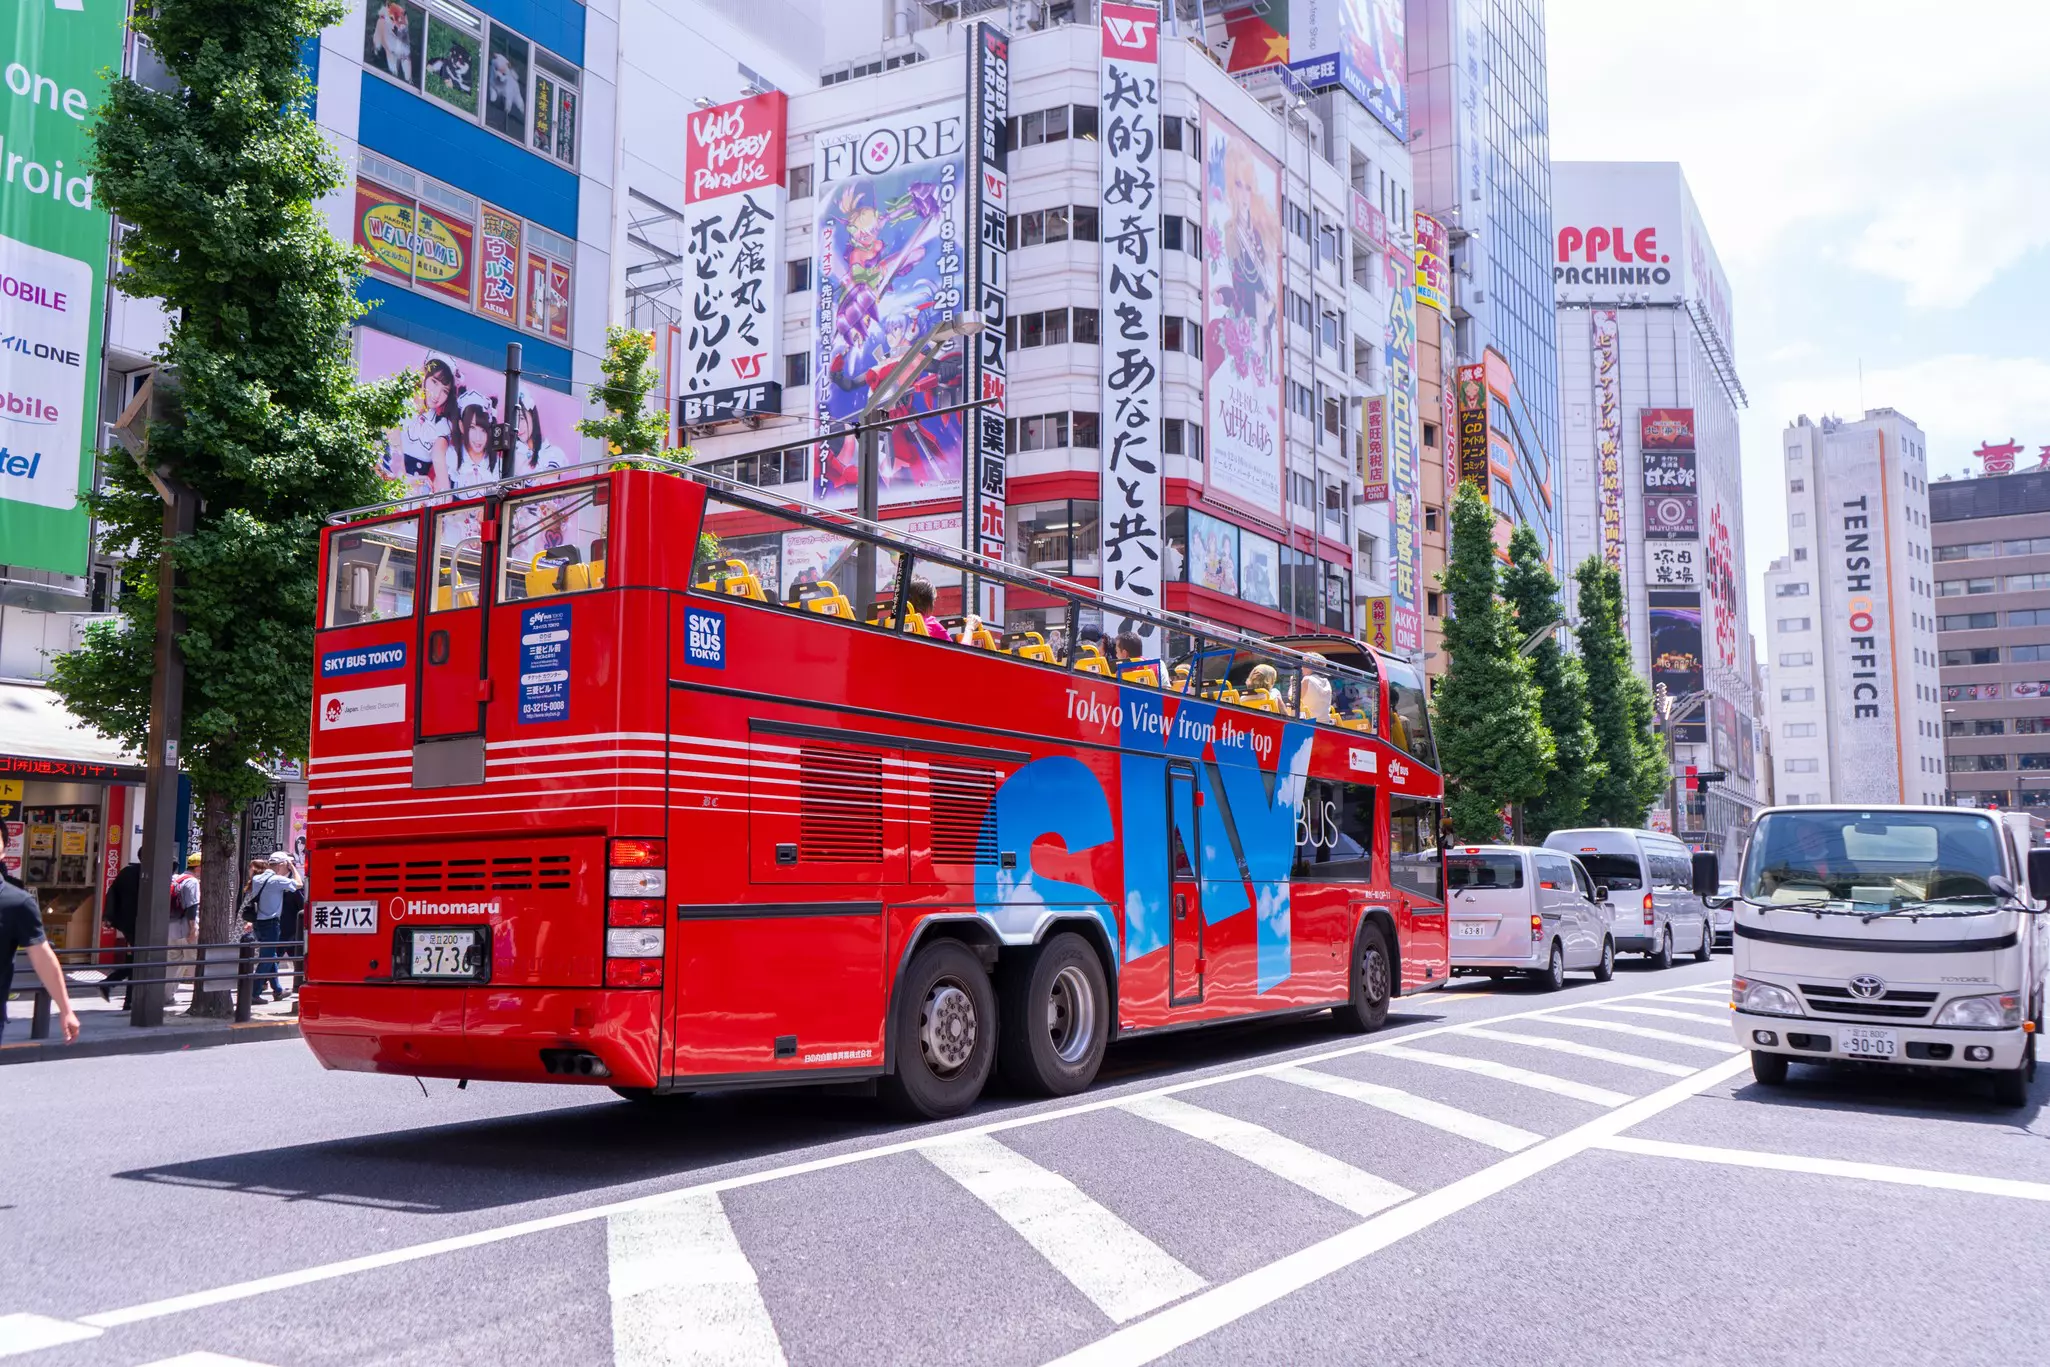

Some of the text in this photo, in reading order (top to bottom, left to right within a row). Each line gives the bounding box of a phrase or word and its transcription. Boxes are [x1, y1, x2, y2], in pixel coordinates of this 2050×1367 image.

[5, 62, 88, 121] one
[996, 40, 1008, 128] HOBBY
[983, 32, 997, 162] PARADISE
[819, 115, 965, 185] FIORE
[0, 135, 94, 211] roid
[693, 157, 770, 200] Paradise
[368, 215, 460, 269] WELCOME
[1552, 226, 1671, 264] PPLE.
[417, 260, 444, 276] AKIBA
[729, 192, 775, 347] 全館丸々
[1553, 266, 1671, 285] PACHINKO
[0, 273, 67, 312] OBILE
[483, 301, 510, 317] AKIBA
[1390, 259, 1409, 356] TAX
[0, 332, 32, 355] イル
[1392, 356, 1412, 485] FREE
[1462, 410, 1485, 422] ゲーム
[1465, 422, 1482, 434] CD
[1367, 399, 1384, 482] 愛客旺免税店
[1462, 435, 1485, 446] アイドル
[1462, 448, 1486, 459] アニメ
[1644, 455, 1656, 464] 7F
[1462, 461, 1486, 472] コミック
[1644, 467, 1696, 488] 甘太郎
[1365, 484, 1387, 494] AKKY
[1367, 492, 1385, 500] ONE
[1843, 495, 1880, 719] TENSHO OFFICE
[688, 613, 722, 636] SKY
[1395, 610, 1419, 632] AKKY
[689, 630, 721, 652] BUS
[1373, 622, 1386, 649] TAX
[1397, 629, 1417, 648] ONE
[324, 648, 404, 671] SKY BUS TOKYO
[690, 647, 721, 662] TOKYO
[553, 683, 563, 692] 1F
[1065, 687, 1273, 761] Tokyo View from the top
[252, 819, 275, 830] TCG
[1293, 798, 1339, 849] BUS
[314, 905, 373, 929] 乗合バス
[407, 900, 500, 916] Hinomaru
[442, 934, 459, 945] 200
[1851, 1037, 1895, 1055] 90-03
